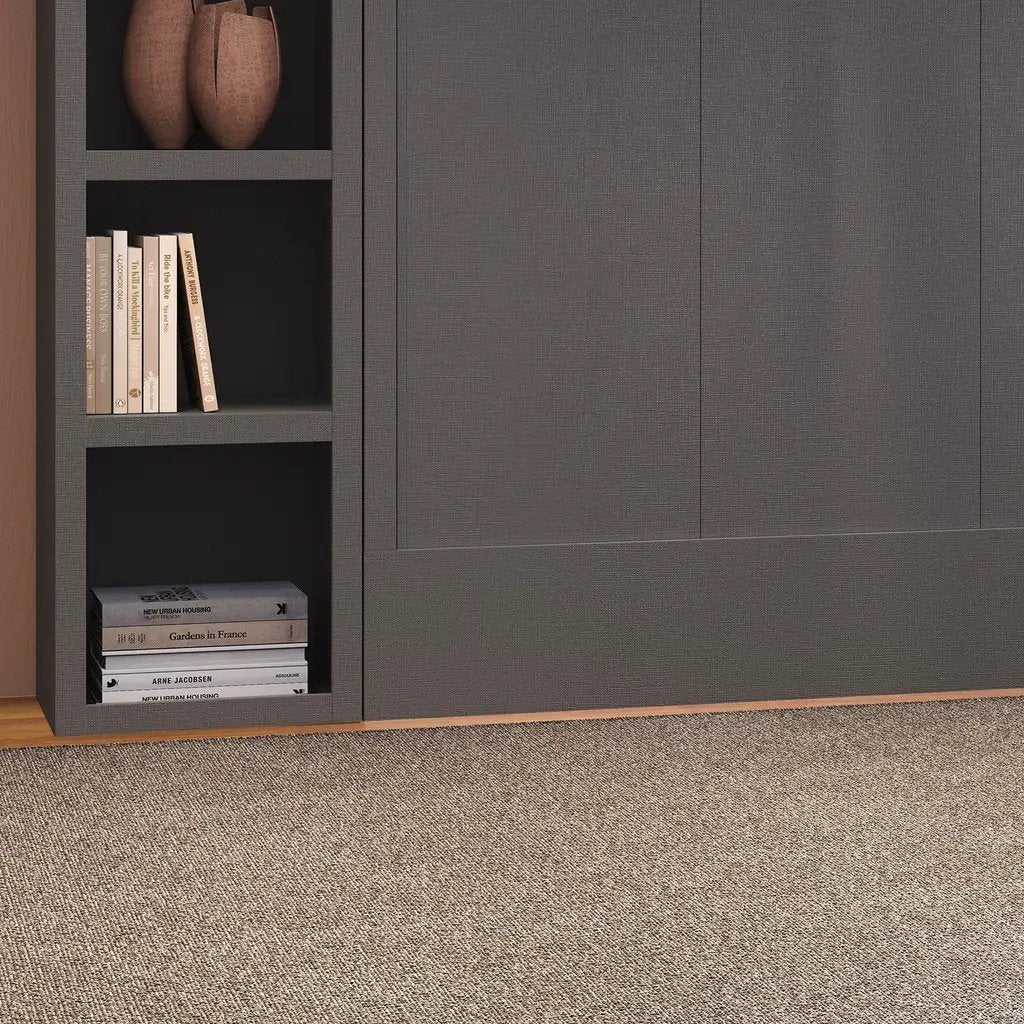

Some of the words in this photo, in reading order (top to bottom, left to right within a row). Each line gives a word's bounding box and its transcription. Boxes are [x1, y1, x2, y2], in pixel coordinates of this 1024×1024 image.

[99, 253, 109, 262] BE
[131, 261, 140, 270] To
[163, 254, 172, 270] Ride
[184, 250, 196, 278] ANTHONY
[99, 265, 109, 286] YOUR
[131, 271, 140, 284] Kill
[163, 272, 172, 284] the
[99, 288, 109, 311] OWN
[163, 285, 172, 299] bike
[188, 280, 199, 305] BURGESS
[130, 291, 140, 335] Mockingbird
[195, 322, 207, 361] CLOCKWORK
[200, 362, 211, 387] ORANGE
[169, 632, 206, 641] Gardens
[206, 631, 216, 639] in
[217, 630, 248, 639] France
[152, 677, 172, 685] ARNE
[173, 675, 213, 684] JACOBSEN
